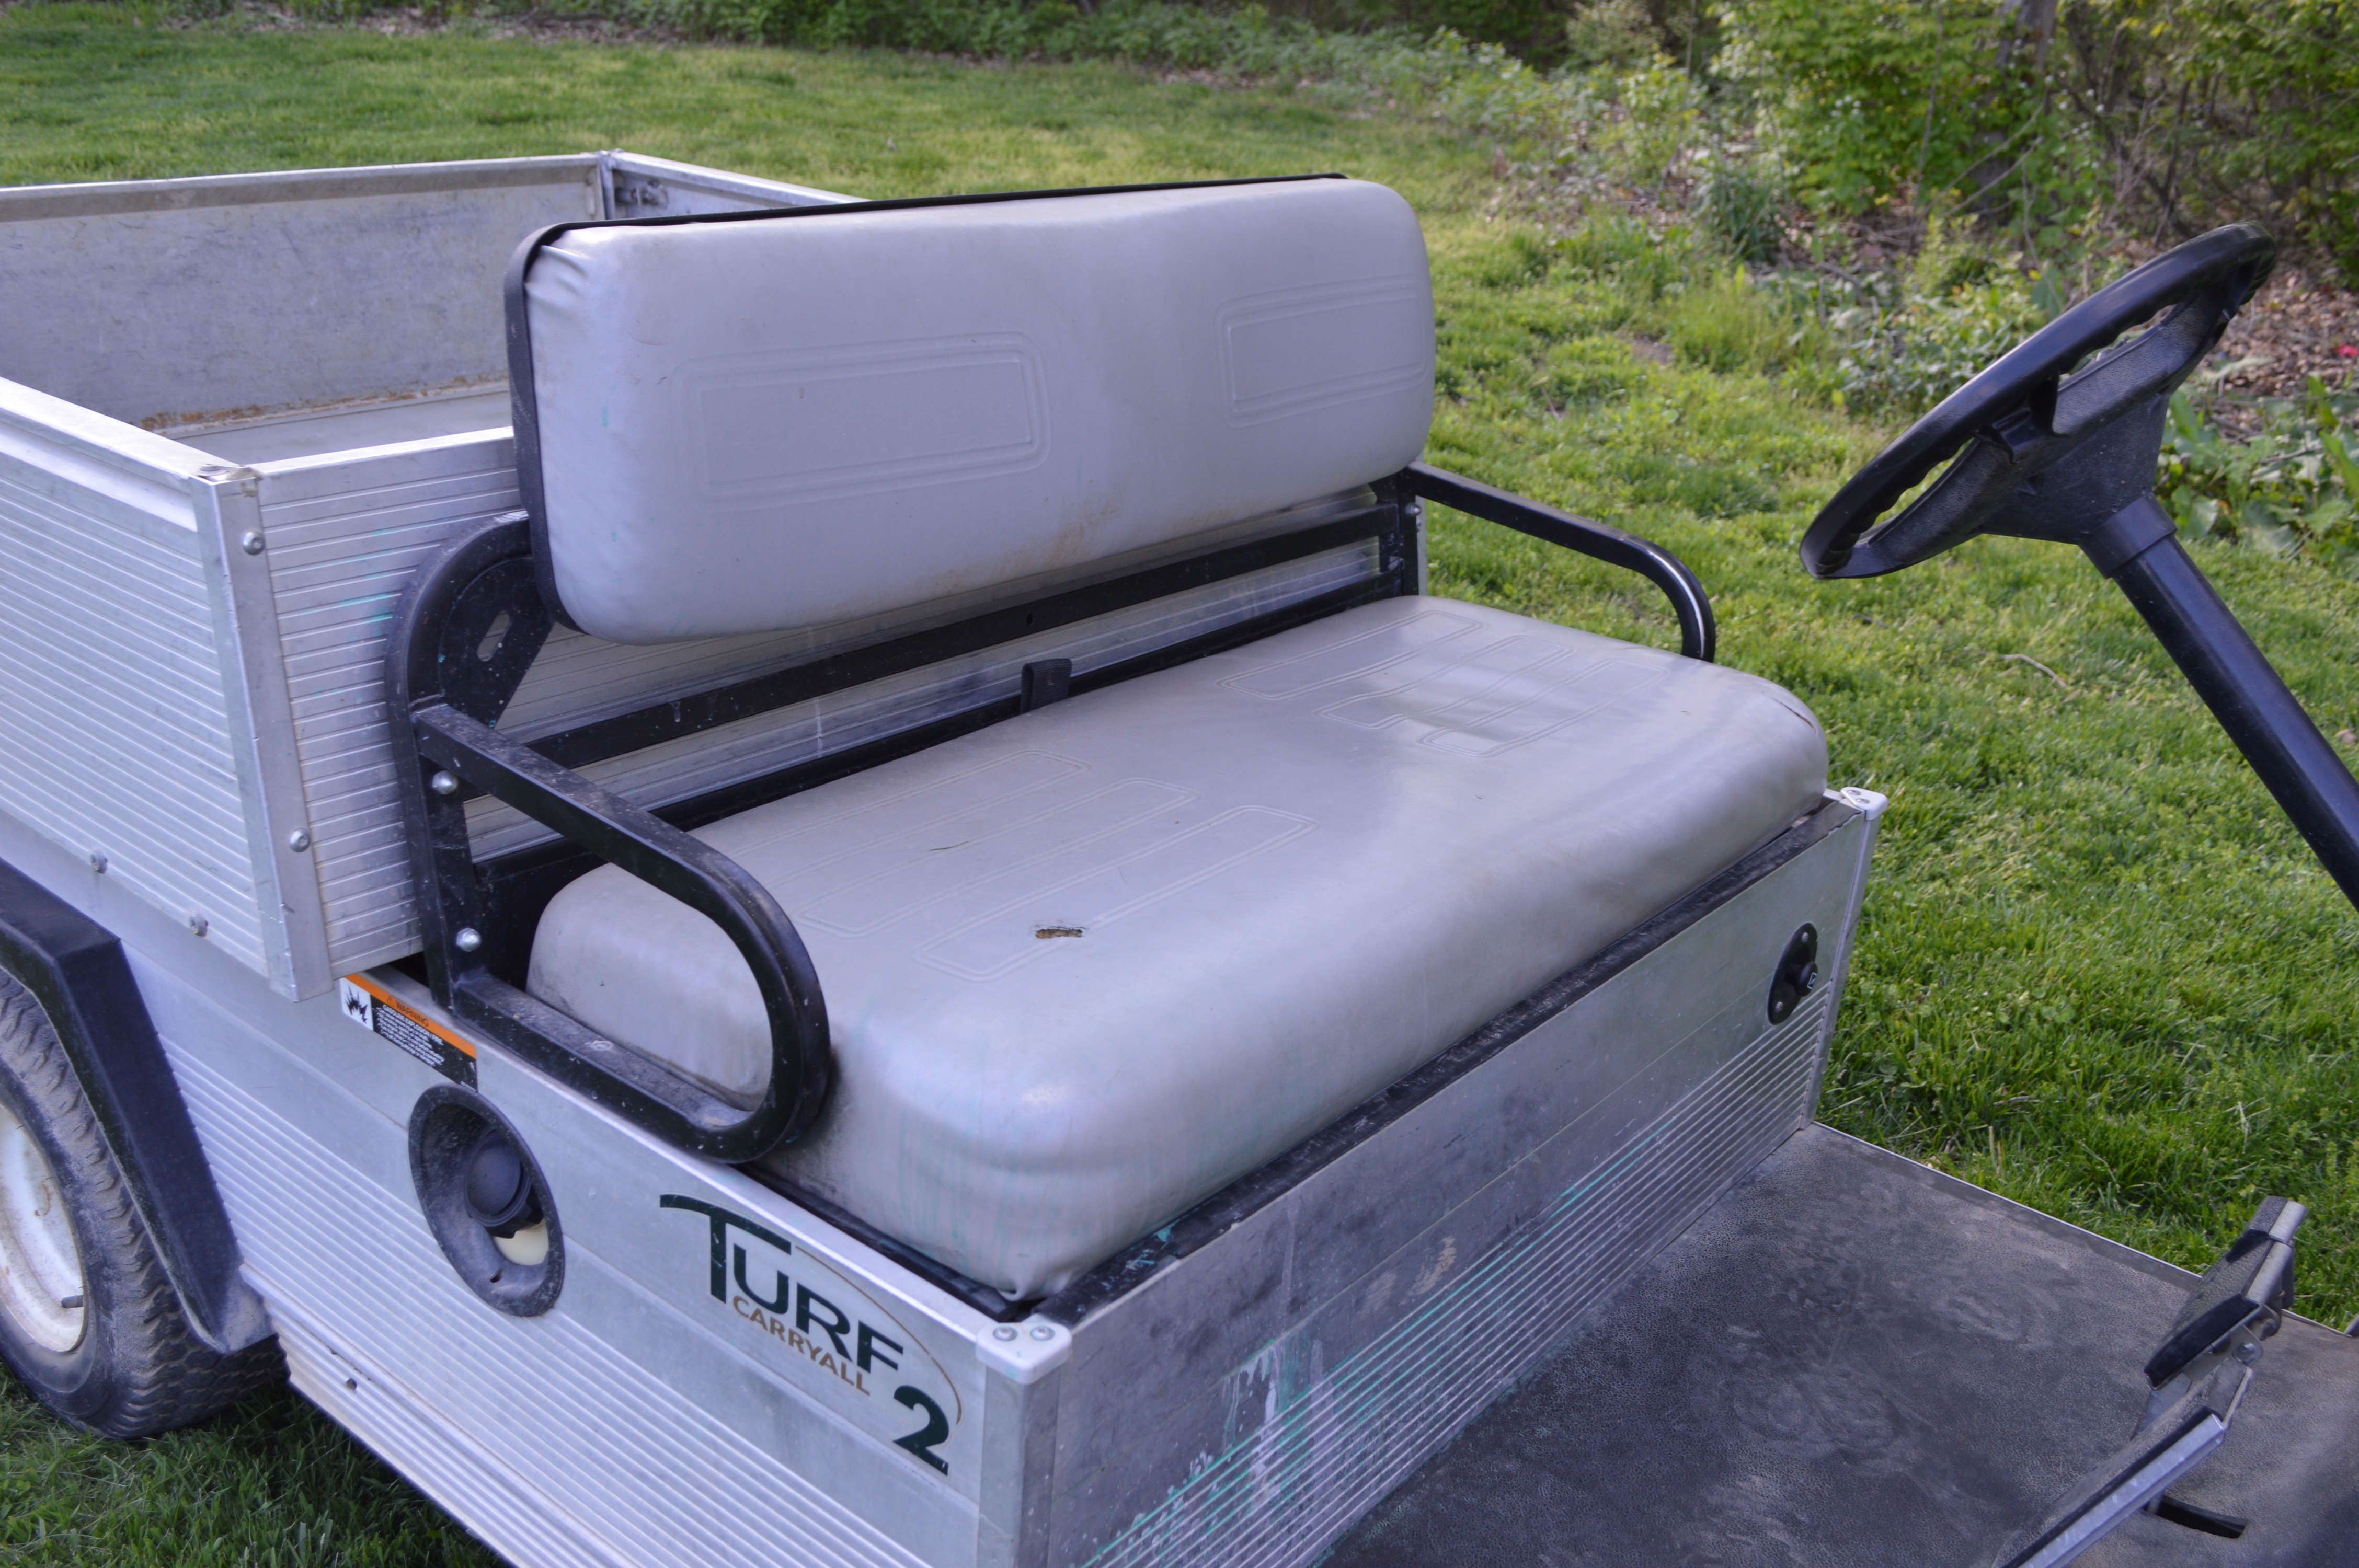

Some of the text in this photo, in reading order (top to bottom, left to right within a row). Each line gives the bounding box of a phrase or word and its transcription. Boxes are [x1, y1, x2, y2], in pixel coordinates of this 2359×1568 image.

[383, 1004, 405, 1020] GASOLINE
[405, 1018, 430, 1037] EXPLOSION
[396, 1000, 429, 1027] WARNING
[660, 1194, 903, 1373] TURF
[732, 1295, 870, 1396] CARRYALL
[892, 1385, 949, 1477] 2
